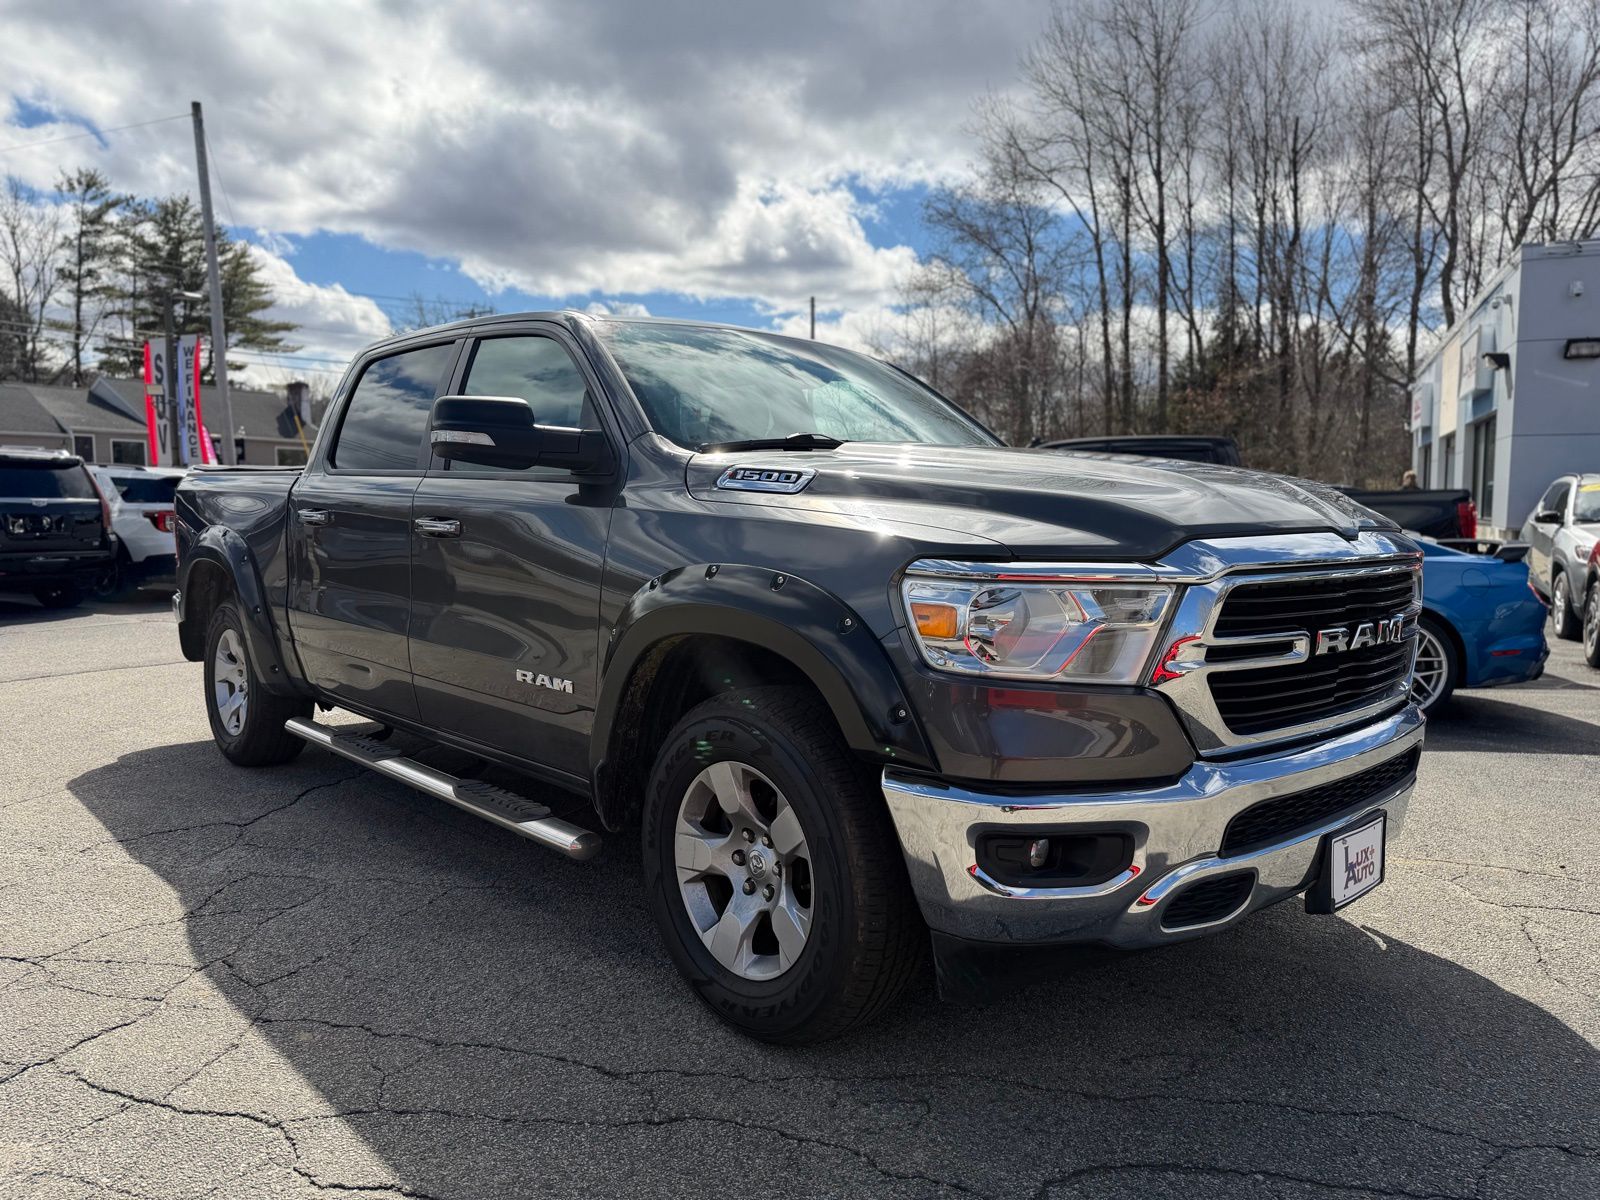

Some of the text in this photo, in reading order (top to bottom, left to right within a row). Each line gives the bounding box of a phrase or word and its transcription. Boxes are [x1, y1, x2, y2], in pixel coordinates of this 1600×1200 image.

[154, 353, 168, 455] SUV
[183, 346, 199, 458] WE FINANCE
[735, 469, 799, 484] 1500
[1316, 614, 1404, 656] RAM
[516, 669, 574, 694] RAM
[1344, 860, 1375, 890] AUTO
